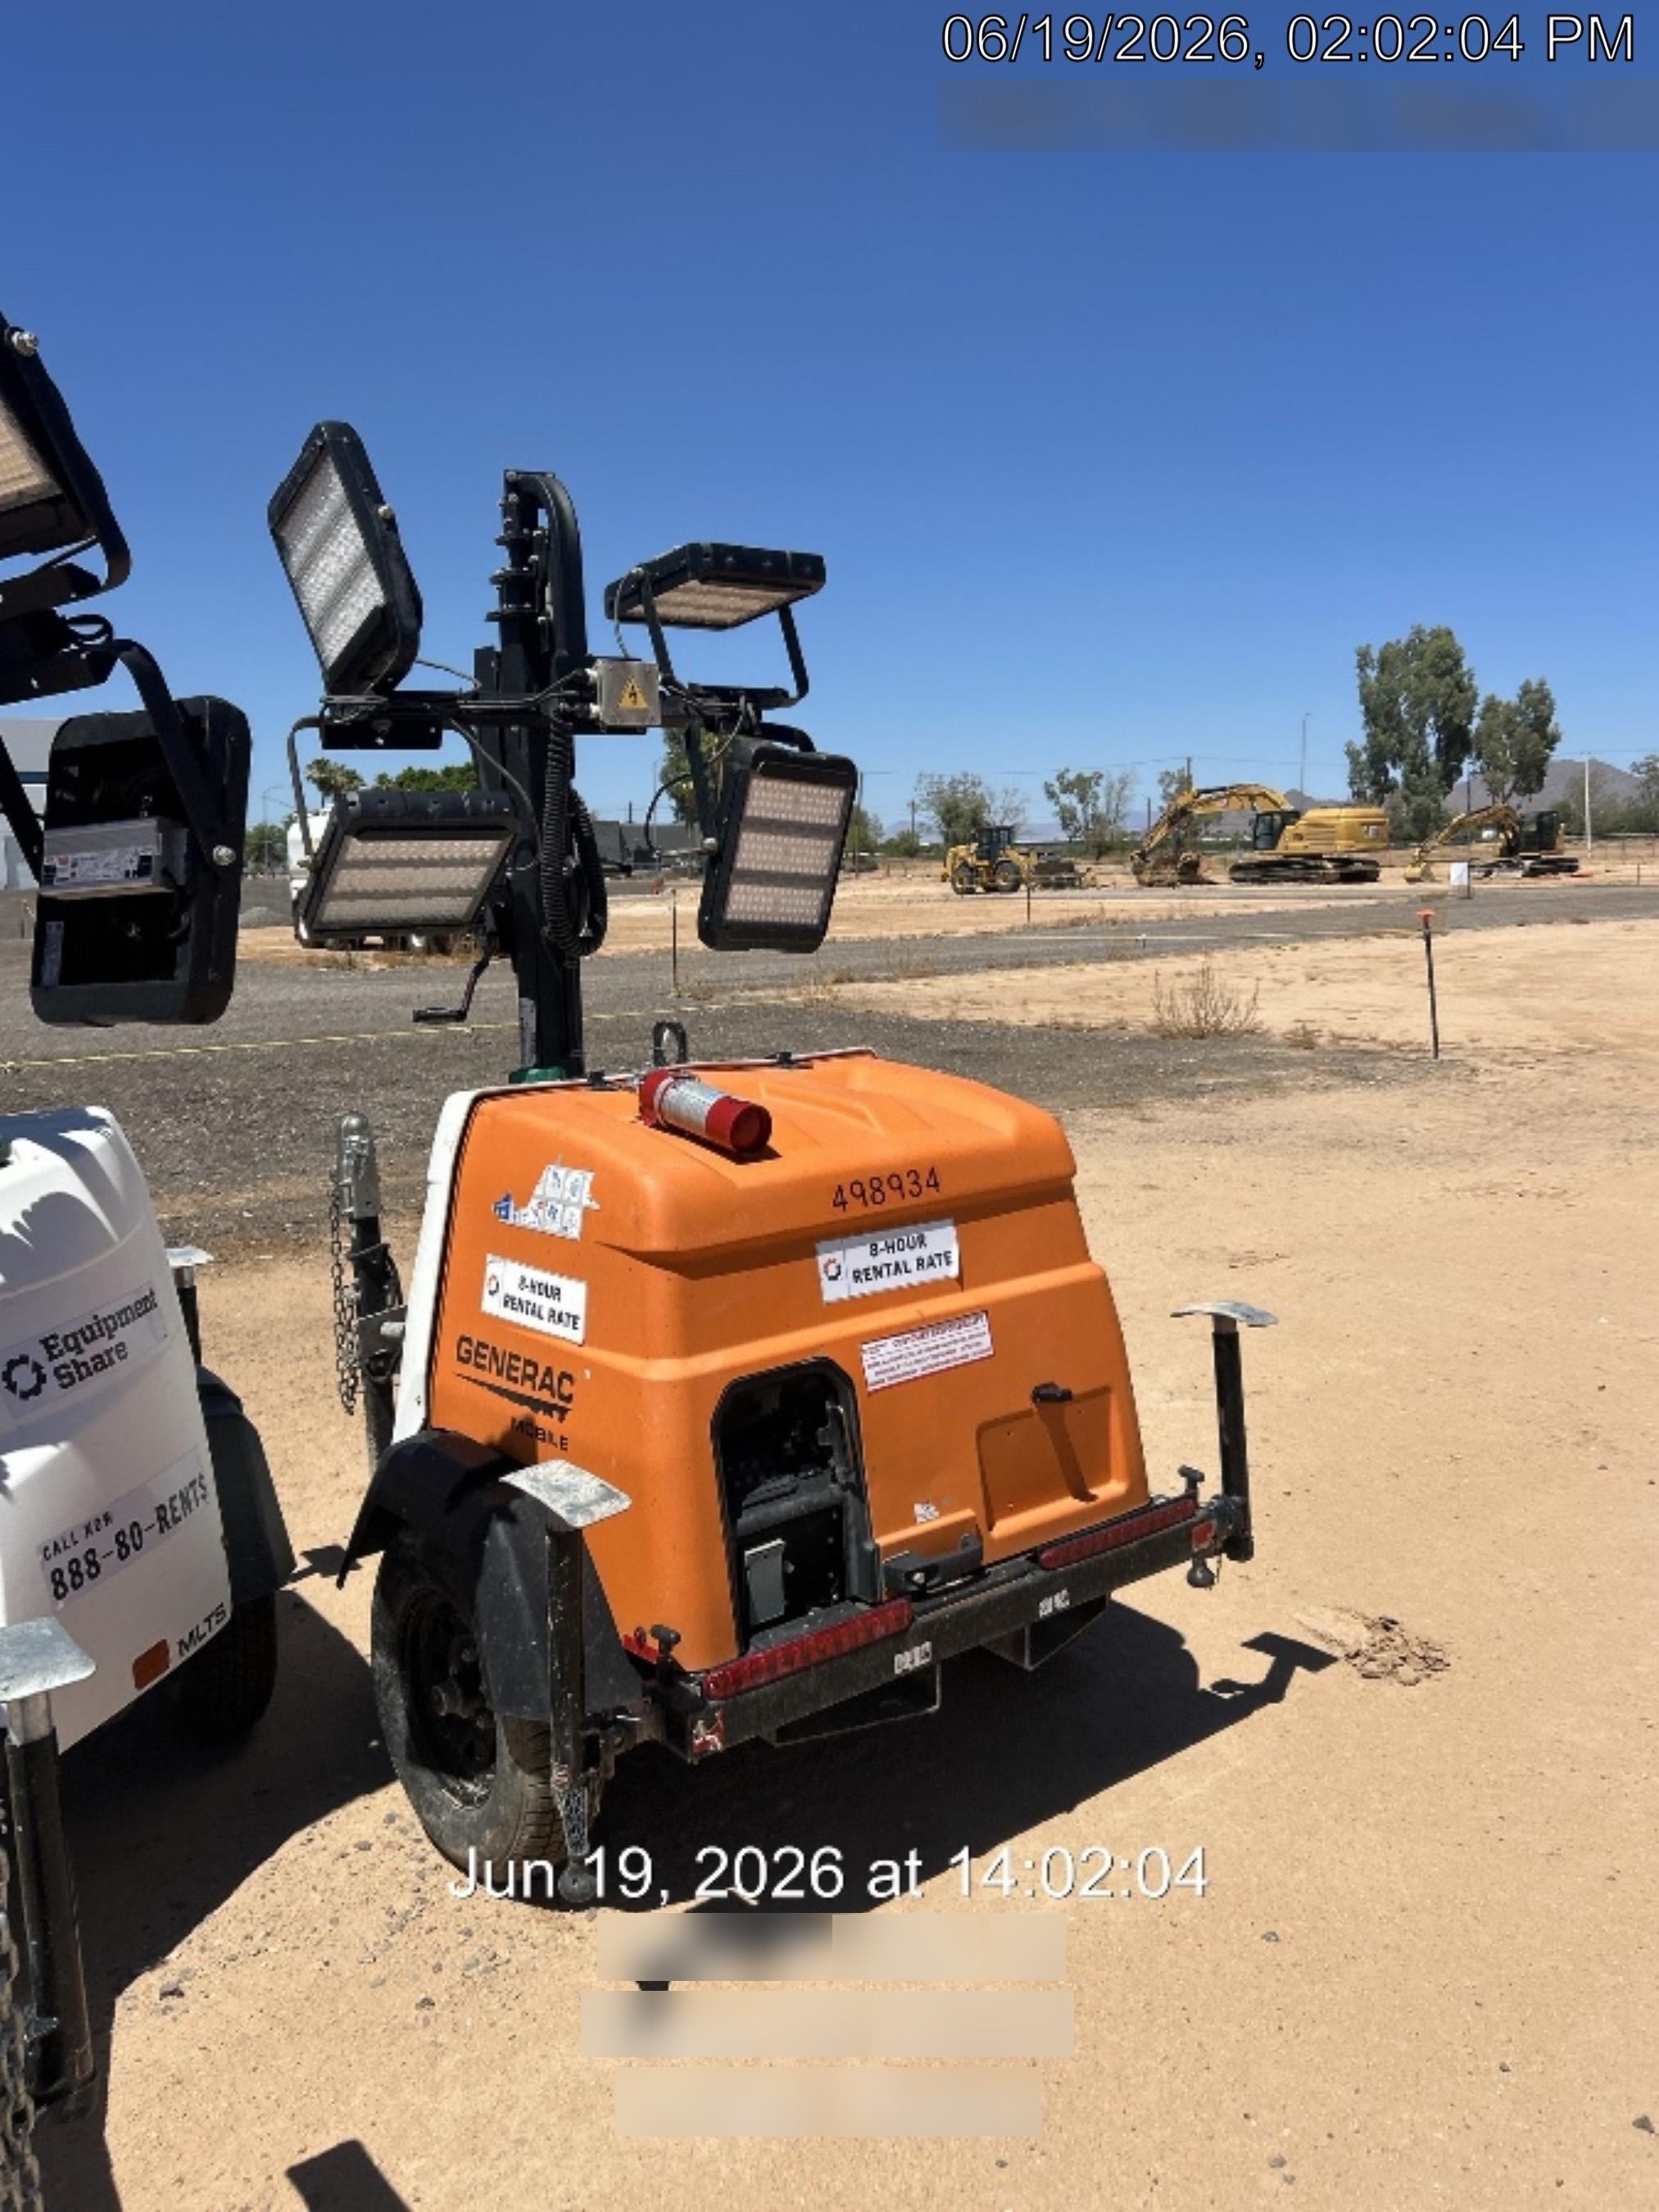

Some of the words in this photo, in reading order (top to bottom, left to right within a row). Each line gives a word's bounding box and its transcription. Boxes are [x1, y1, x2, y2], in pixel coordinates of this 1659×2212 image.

[832, 1167, 941, 1213] 498934
[869, 1233, 927, 1258] 8-HOUR
[852, 1260, 912, 1284] RENTAL
[916, 1250, 953, 1271] RATE
[39, 1287, 158, 1362] Equipment
[503, 1293, 545, 1321] RENTAL
[547, 1308, 581, 1330] RATE
[52, 1341, 129, 1389] Share
[456, 1334, 574, 1404] GENERAC
[510, 1416, 569, 1452] MOBILE
[43, 1530, 79, 1562] CALL
